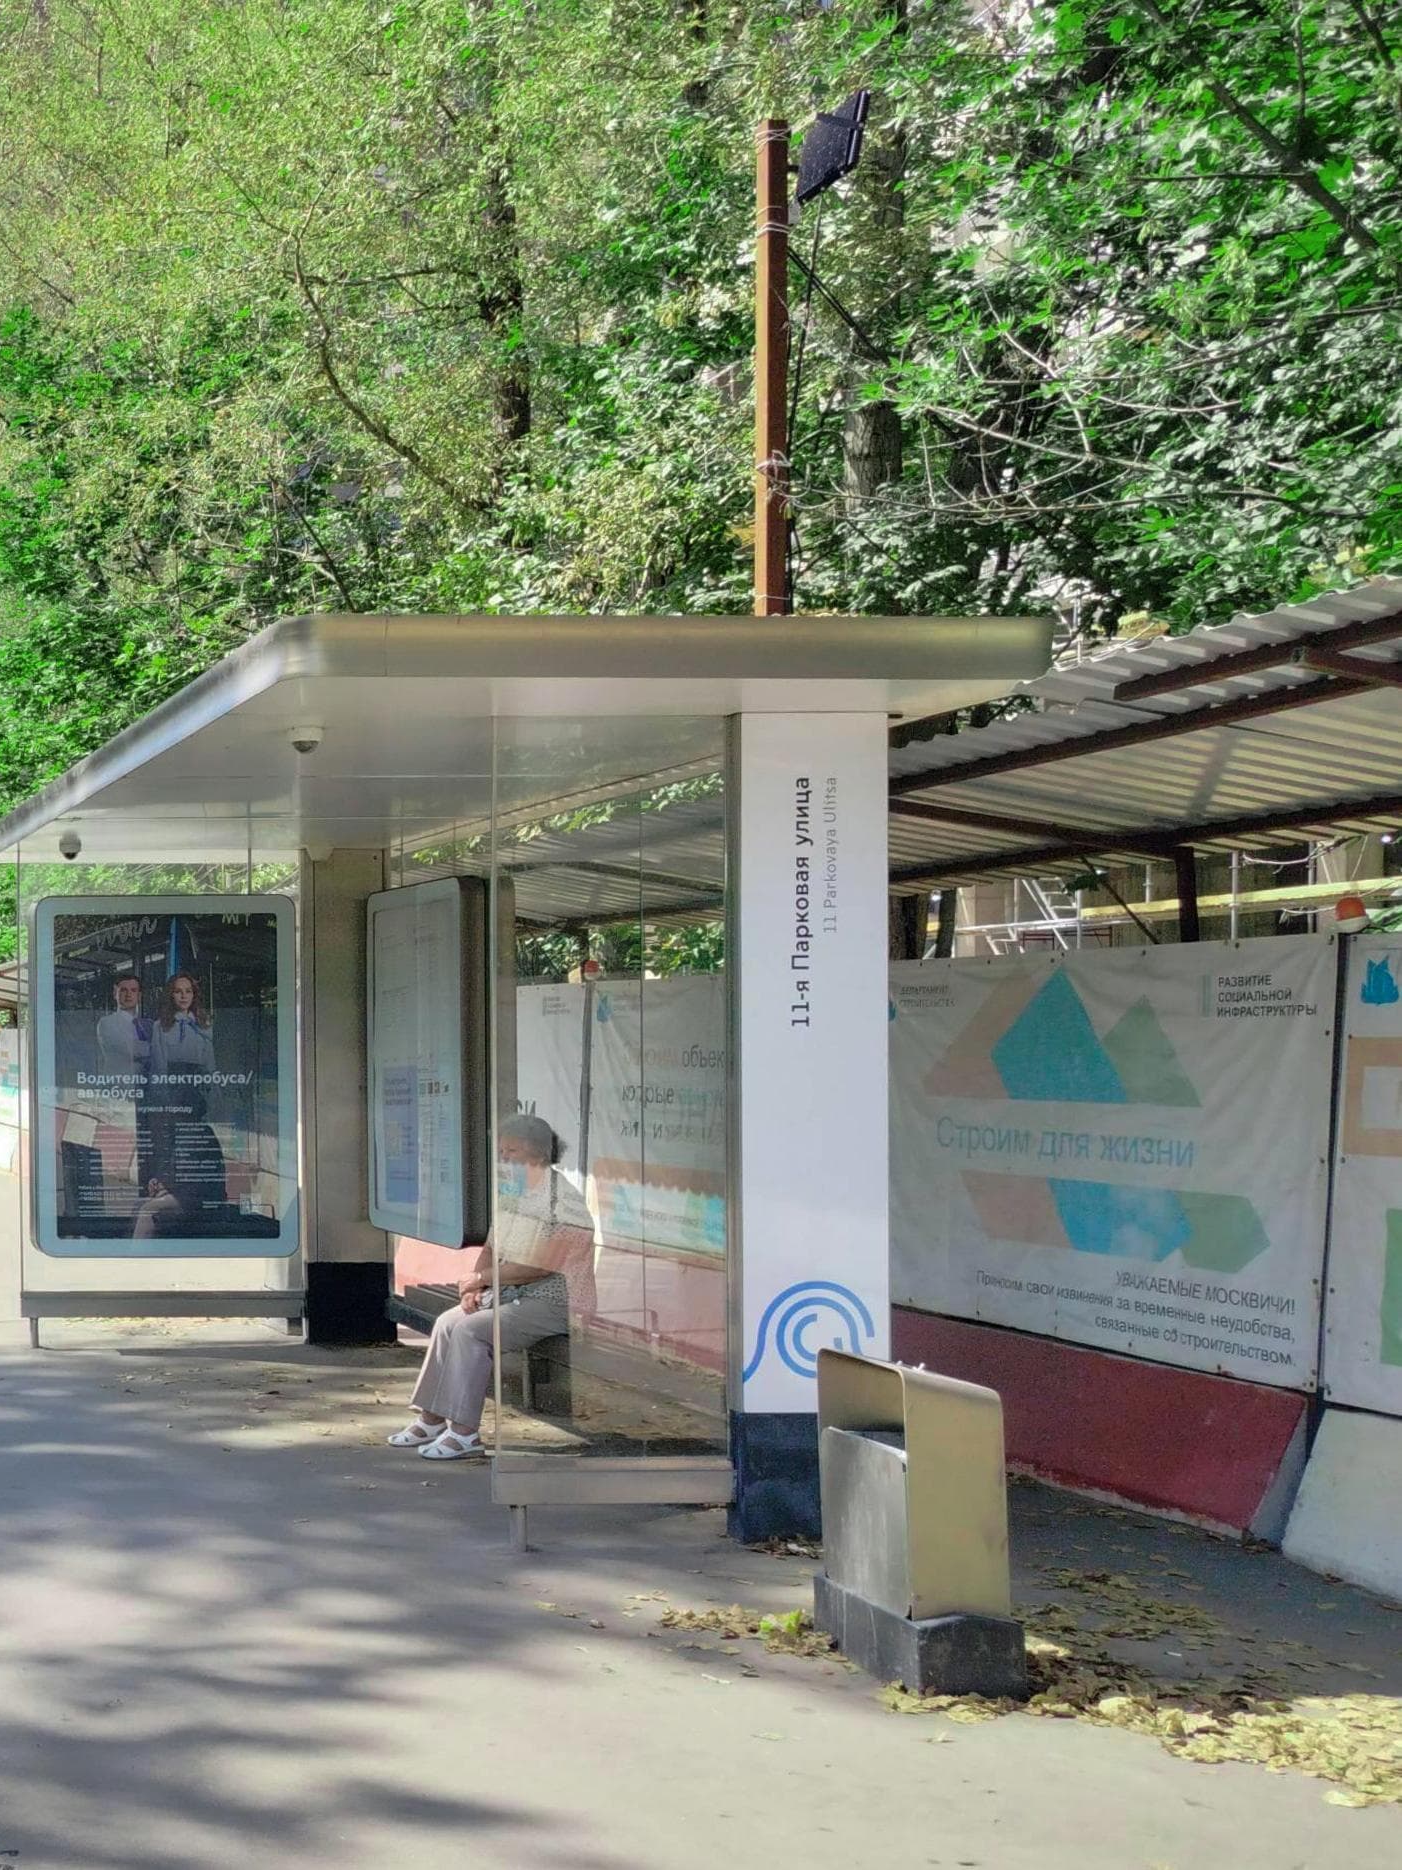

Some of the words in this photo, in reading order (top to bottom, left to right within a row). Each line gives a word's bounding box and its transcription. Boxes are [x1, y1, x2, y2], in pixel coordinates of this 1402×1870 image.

[795, 777, 813, 846] улица
[823, 777, 837, 823] Ulitsa
[823, 828, 839, 910] Parkovaya
[791, 856, 813, 970] Парковая
[823, 914, 838, 933] 11
[791, 980, 810, 1027] 11-я
[1218, 975, 1272, 987] РАЗВИТИЕ
[1218, 988, 1292, 1003] СОЦИАЛЬНОЙ
[1217, 1004, 1317, 1017] ИНФРАСТРУКТУРЫ
[77, 1072, 148, 1085] Водитель
[151, 1070, 254, 1087] электробуса/
[77, 1086, 144, 1101] автобуса
[936, 1116, 1031, 1159] Строим
[1037, 1130, 1091, 1162] для
[1099, 1135, 1194, 1168] жизни
[1026, 1281, 1054, 1296] свои
[1057, 1286, 1113, 1304] извинения
[1116, 1297, 1130, 1310] за
[1134, 1301, 1206, 1326] временные
[1210, 1315, 1295, 1344] неудобства,
[1116, 1270, 1202, 1300] УВАЖАЕМЫЕ
[1204, 1285, 1295, 1315] МОСКВИЧИ!
[1095, 1316, 1160, 1339] связанные
[1180, 1334, 1297, 1366] строительством.
